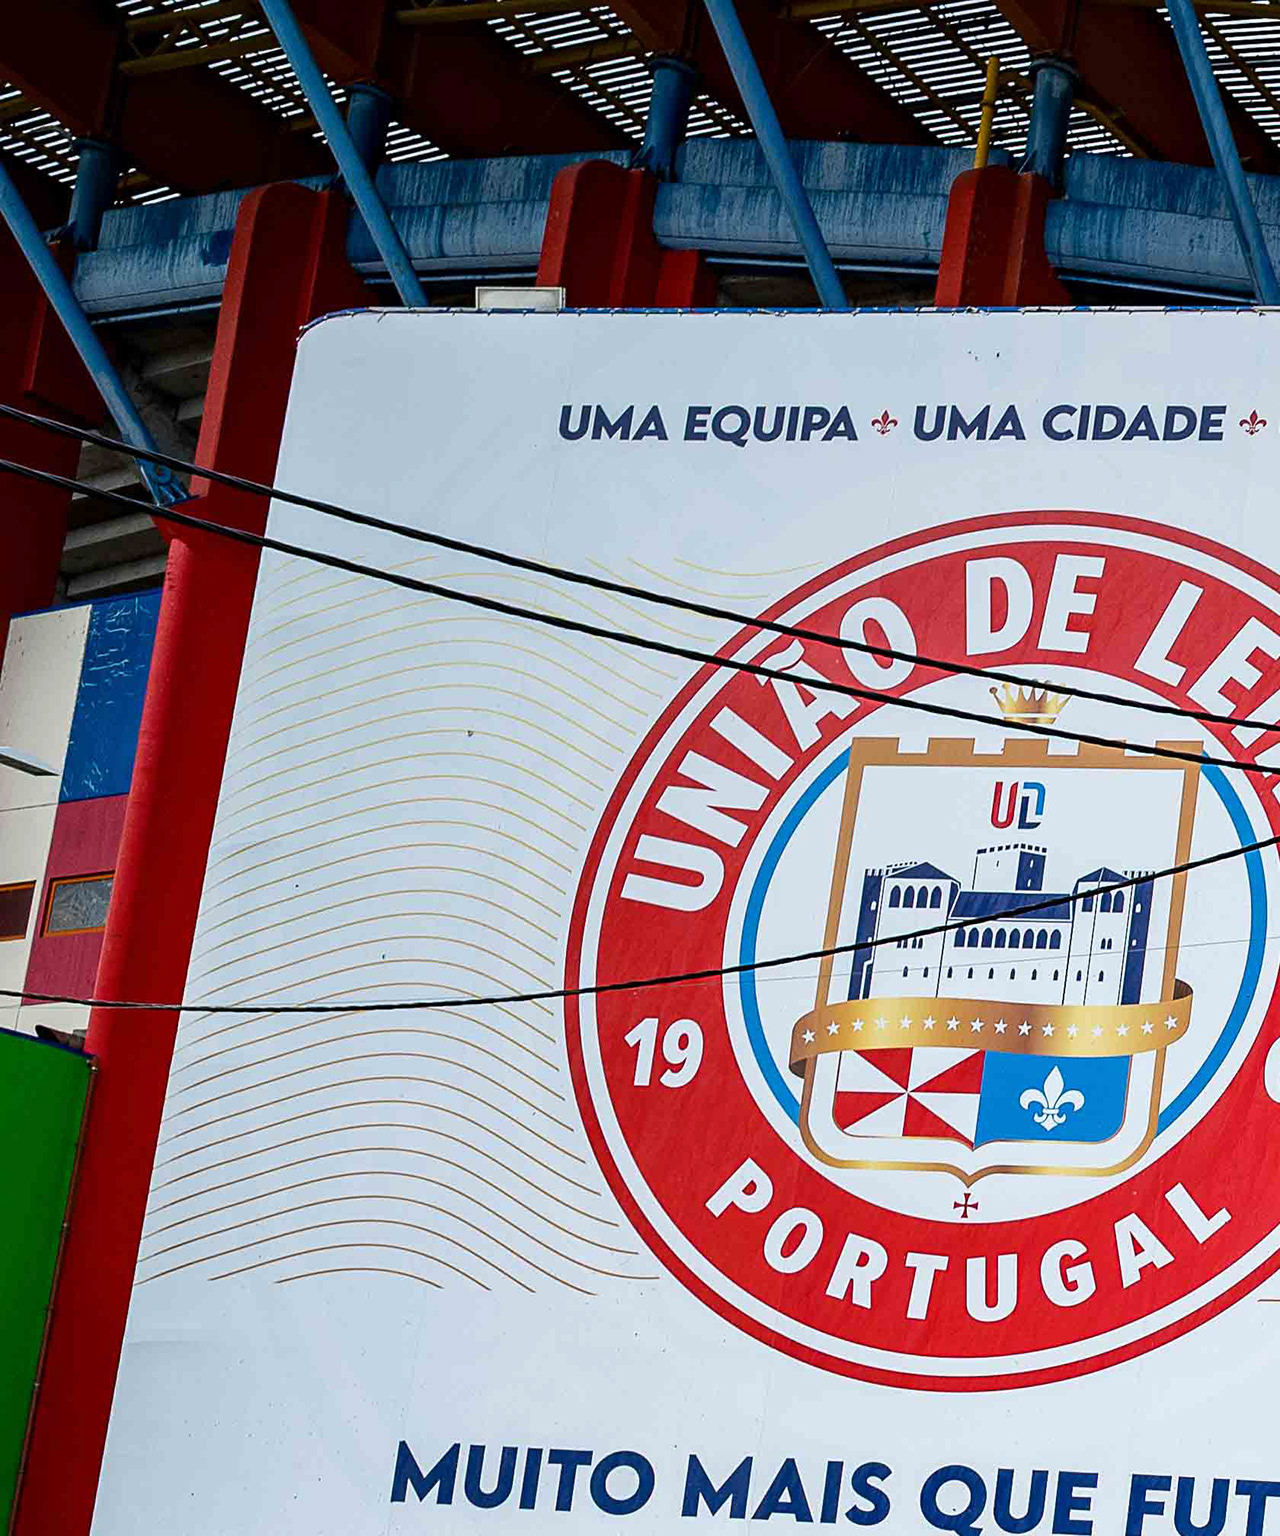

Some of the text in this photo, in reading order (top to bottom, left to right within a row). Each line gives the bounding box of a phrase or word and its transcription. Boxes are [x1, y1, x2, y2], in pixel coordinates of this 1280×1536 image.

[559, 405, 668, 441] UMA
[684, 405, 859, 447] EQUIPA
[913, 405, 1028, 441] UMA
[1043, 405, 1227, 441] CIDADE
[620, 596, 919, 913] UNIÃO
[965, 553, 1107, 657] DE
[624, 1018, 704, 1088] 19
[705, 1157, 1231, 1322] PORTUGAL
[391, 1441, 655, 1516] MUITO
[681, 1454, 893, 1526] MAIS
